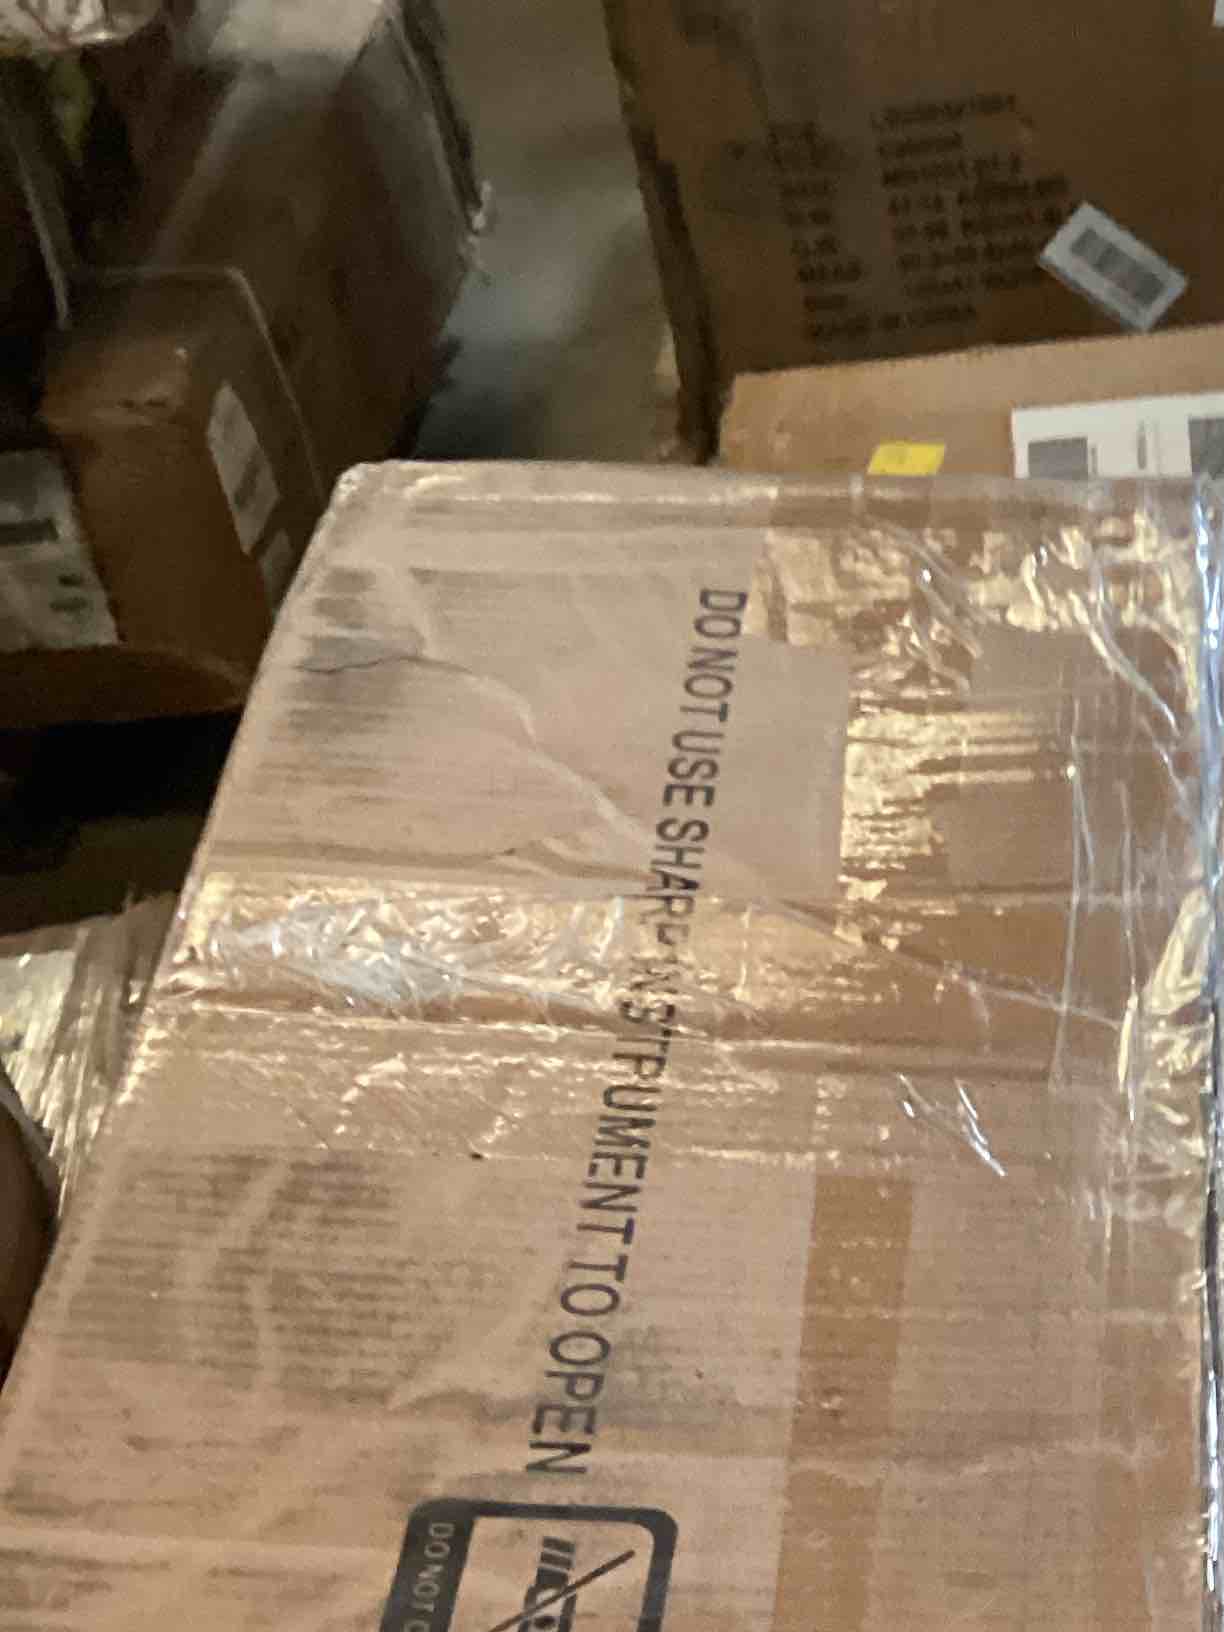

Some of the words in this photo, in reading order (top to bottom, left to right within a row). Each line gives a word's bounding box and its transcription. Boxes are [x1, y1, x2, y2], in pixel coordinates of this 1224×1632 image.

[693, 587, 748, 639] DO
[679, 646, 739, 723] NOT
[662, 729, 726, 808] USE
[560, 1254, 629, 1317] TO
[525, 1330, 612, 1475] OPEN
[424, 1521, 457, 1559] DO
[412, 1563, 445, 1614] NOT
